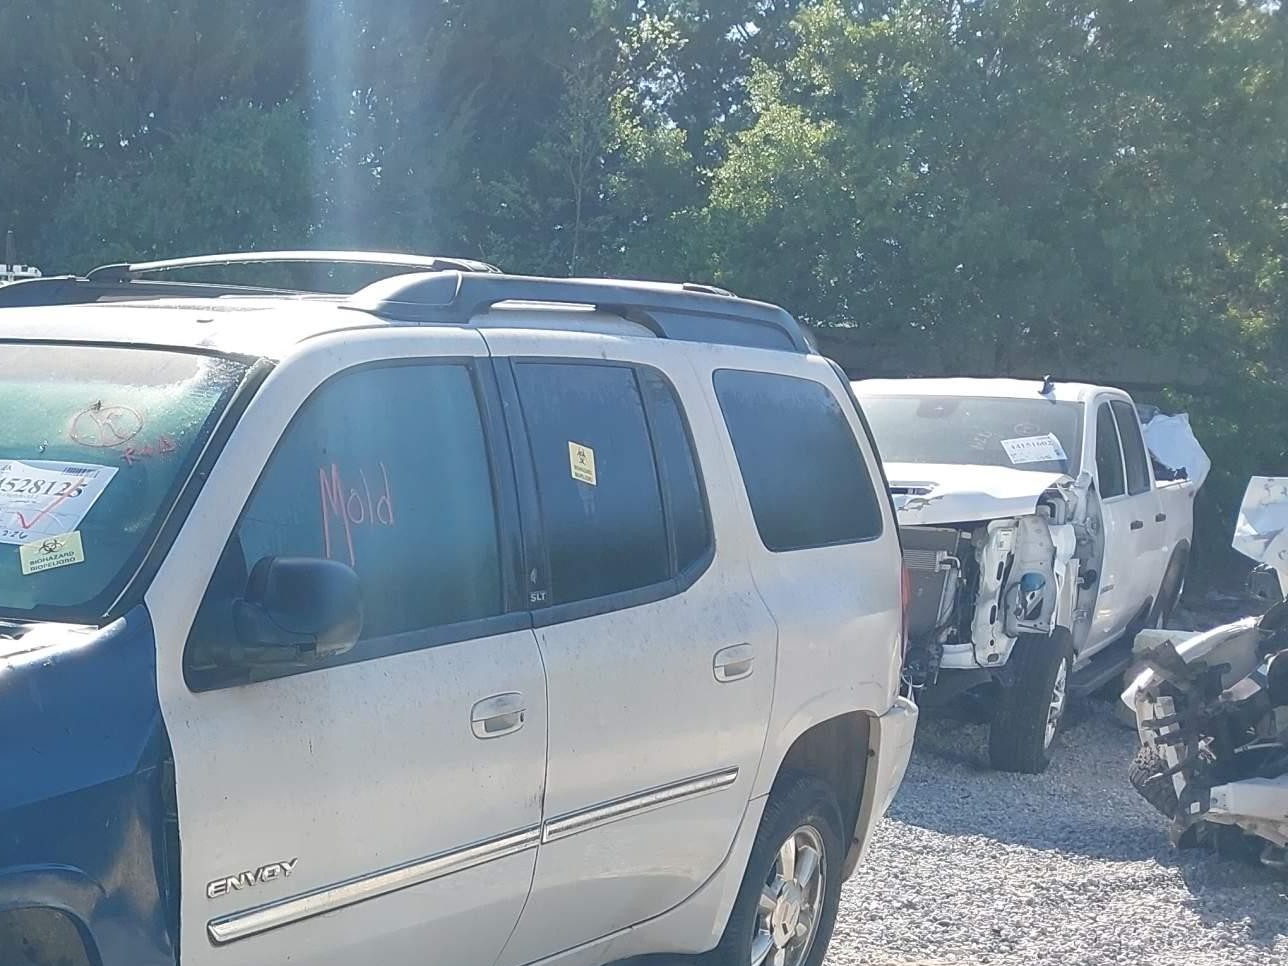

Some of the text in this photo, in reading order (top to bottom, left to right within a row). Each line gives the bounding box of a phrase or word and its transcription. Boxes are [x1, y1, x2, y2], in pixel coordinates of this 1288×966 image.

[319, 461, 395, 567] Mold
[29, 551, 75, 566] BIOHAZARD
[530, 592, 547, 602] SLT
[206, 856, 298, 899] ENVOY
